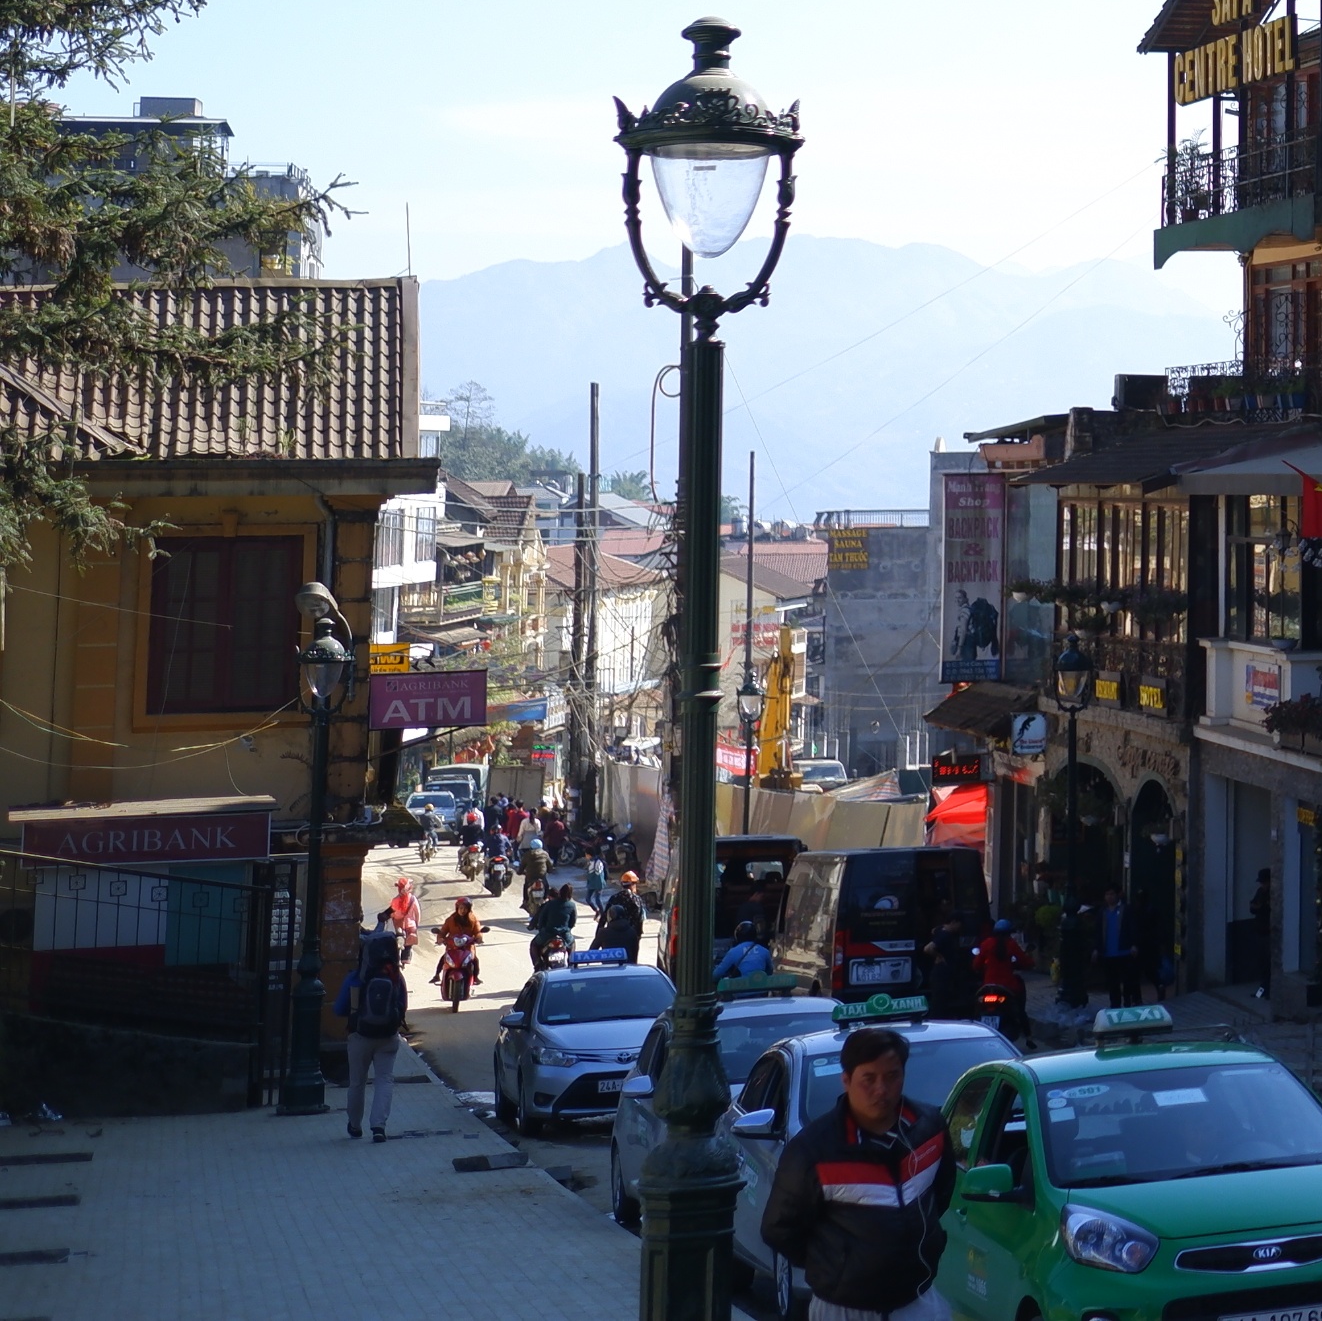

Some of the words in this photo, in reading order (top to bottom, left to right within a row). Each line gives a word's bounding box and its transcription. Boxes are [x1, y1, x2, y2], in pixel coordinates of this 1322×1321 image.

[1173, 32, 1240, 106] CENTRE
[1240, 13, 1296, 85] HOTEL
[958, 496, 990, 508] Shop
[829, 529, 868, 538] MASSAGE
[947, 516, 1000, 539] BACKPACK
[834, 539, 863, 548] SAUNA
[947, 559, 999, 584] BACKPACK
[400, 679, 469, 693] AGRIBANK
[382, 696, 472, 724] ATM
[57, 825, 237, 856] AGRIBANK
[840, 1004, 867, 1015] TAXI
[891, 997, 923, 1011] XANH
[1107, 1008, 1162, 1024] TAXI
[600, 1080, 624, 1093] 24A-
[1258, 1246, 1278, 1259] KIA
